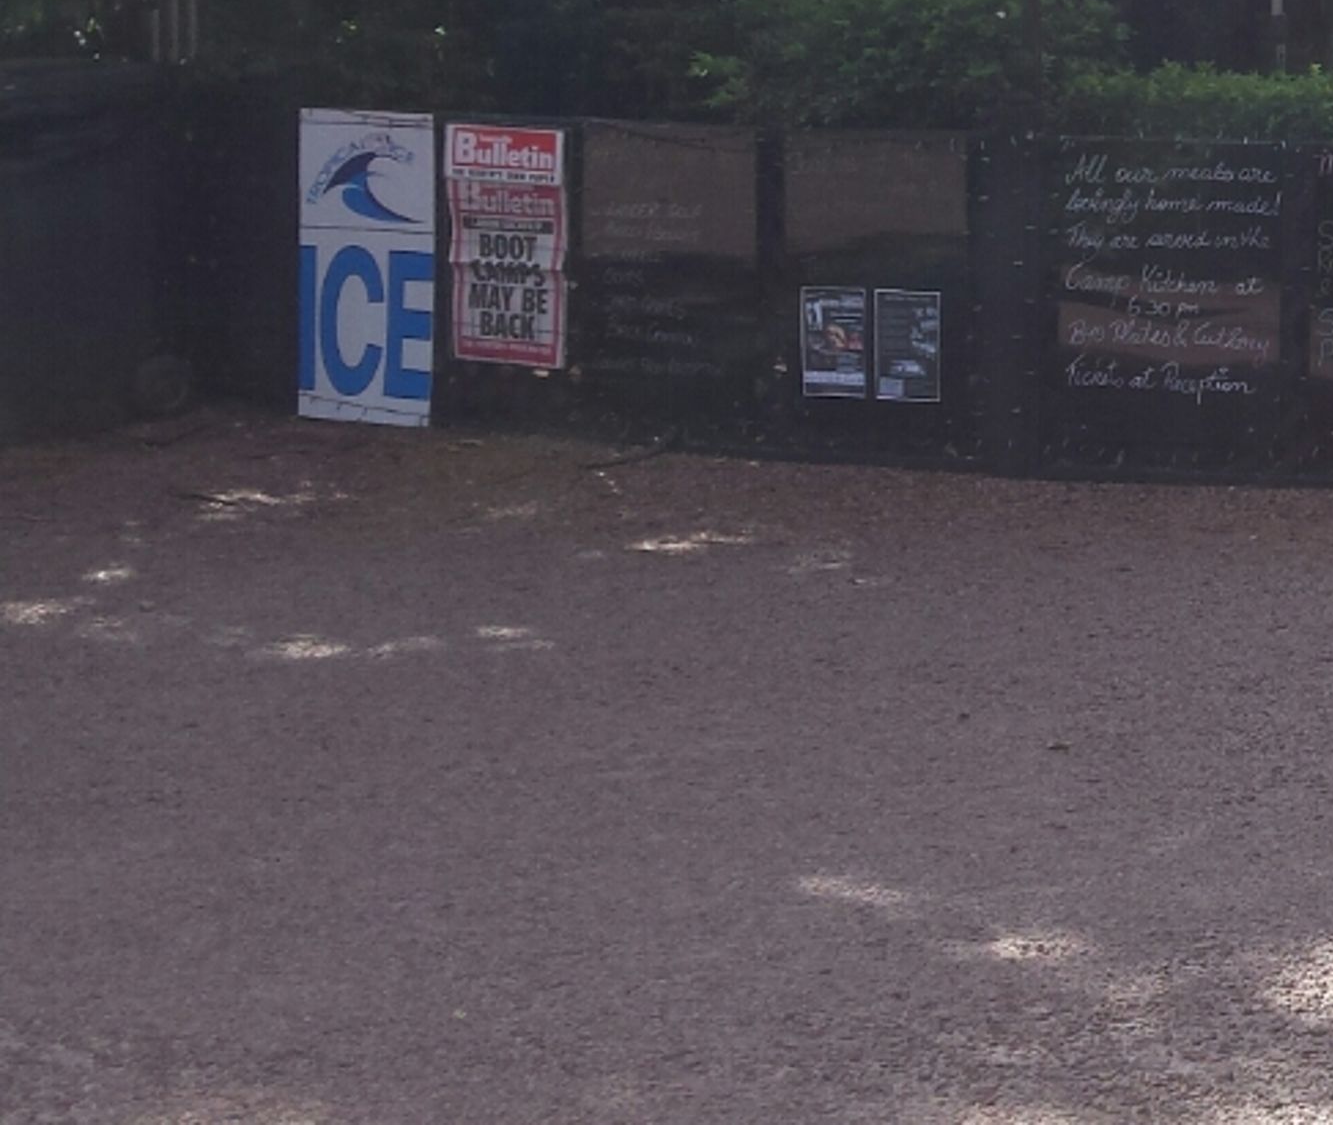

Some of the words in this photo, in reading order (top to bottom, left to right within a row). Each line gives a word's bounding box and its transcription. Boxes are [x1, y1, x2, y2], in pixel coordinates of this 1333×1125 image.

[454, 130, 555, 169] Bulletin
[478, 233, 537, 262] BOOT
[1138, 263, 1219, 295] Kitchen
[1234, 274, 1266, 296] at
[467, 283, 516, 312] MAY
[521, 287, 549, 315] BE
[298, 244, 436, 402] ICE
[479, 311, 536, 340] BACK
